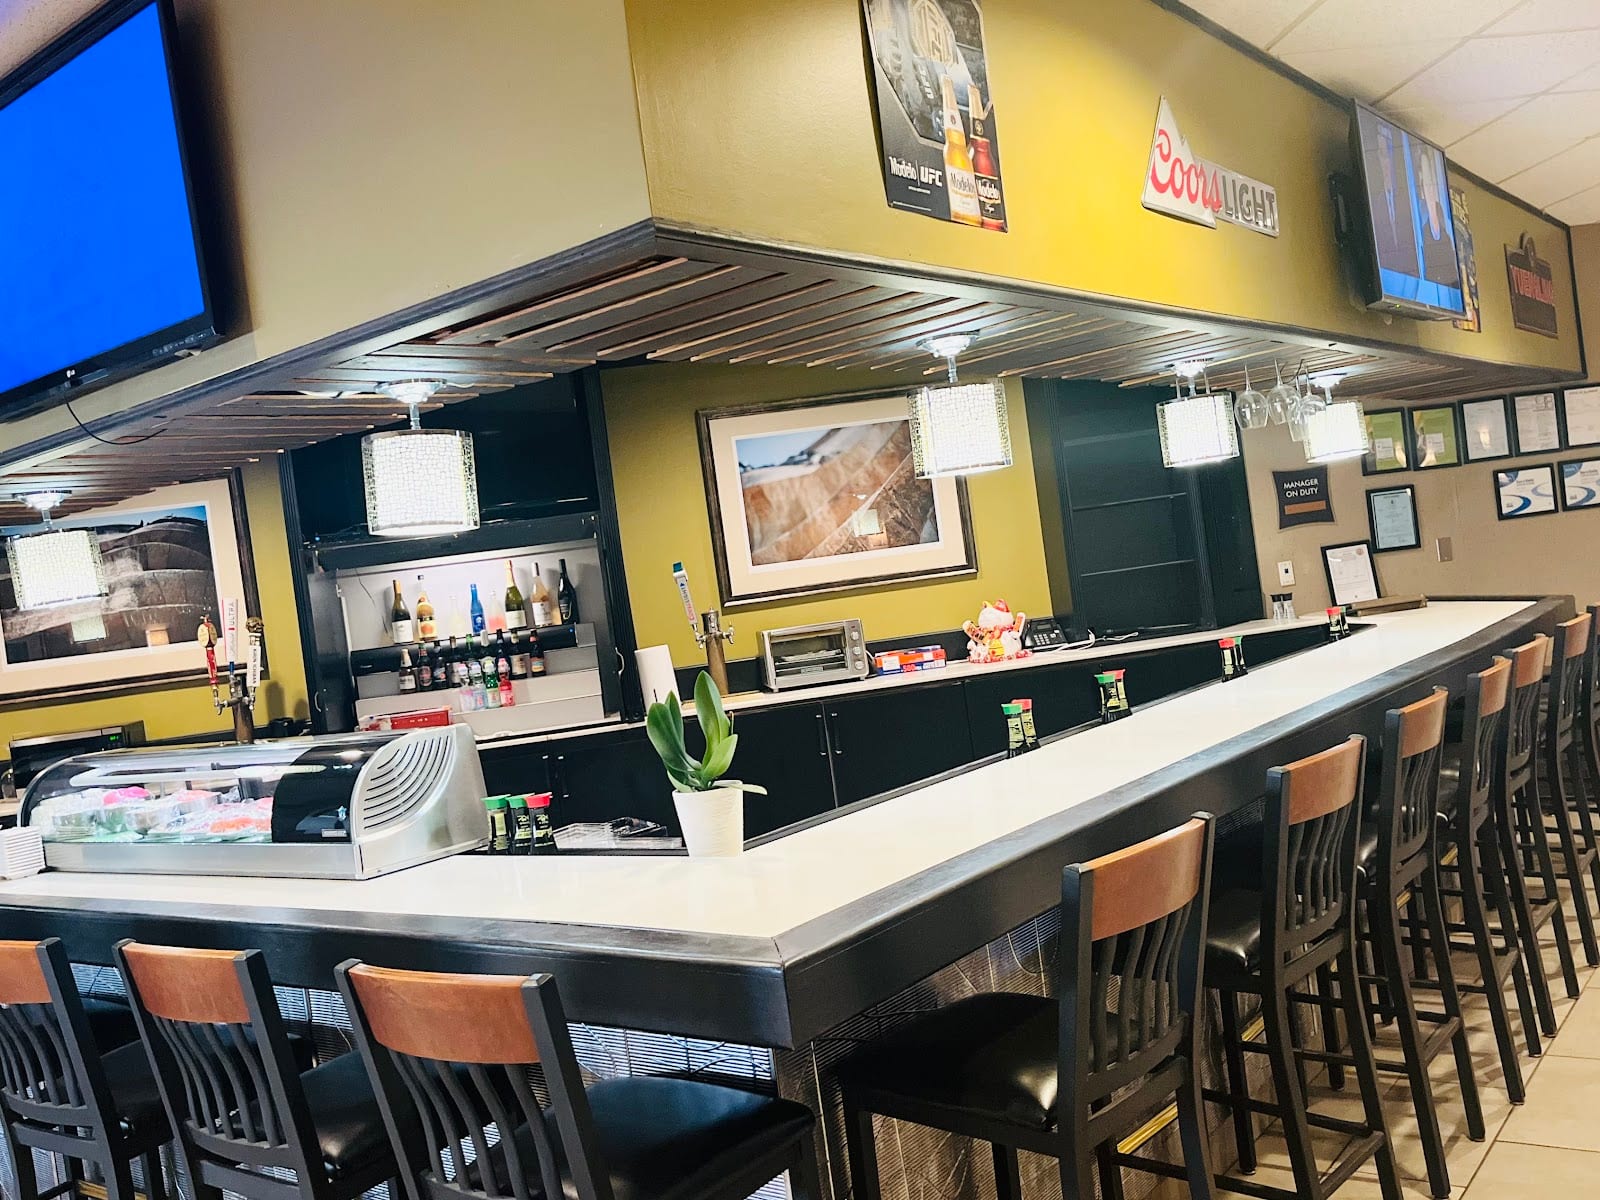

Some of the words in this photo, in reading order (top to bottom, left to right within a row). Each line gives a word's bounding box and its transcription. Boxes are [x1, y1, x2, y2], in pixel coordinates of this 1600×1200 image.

[888, 156, 917, 181] Modelo
[920, 166, 943, 187] UFC
[1150, 128, 1223, 214] Coors
[1222, 174, 1277, 231] LIGHT
[1283, 478, 1319, 490] MANAGER
[1286, 490, 1298, 498] ON
[1299, 487, 1319, 497] DUTY
